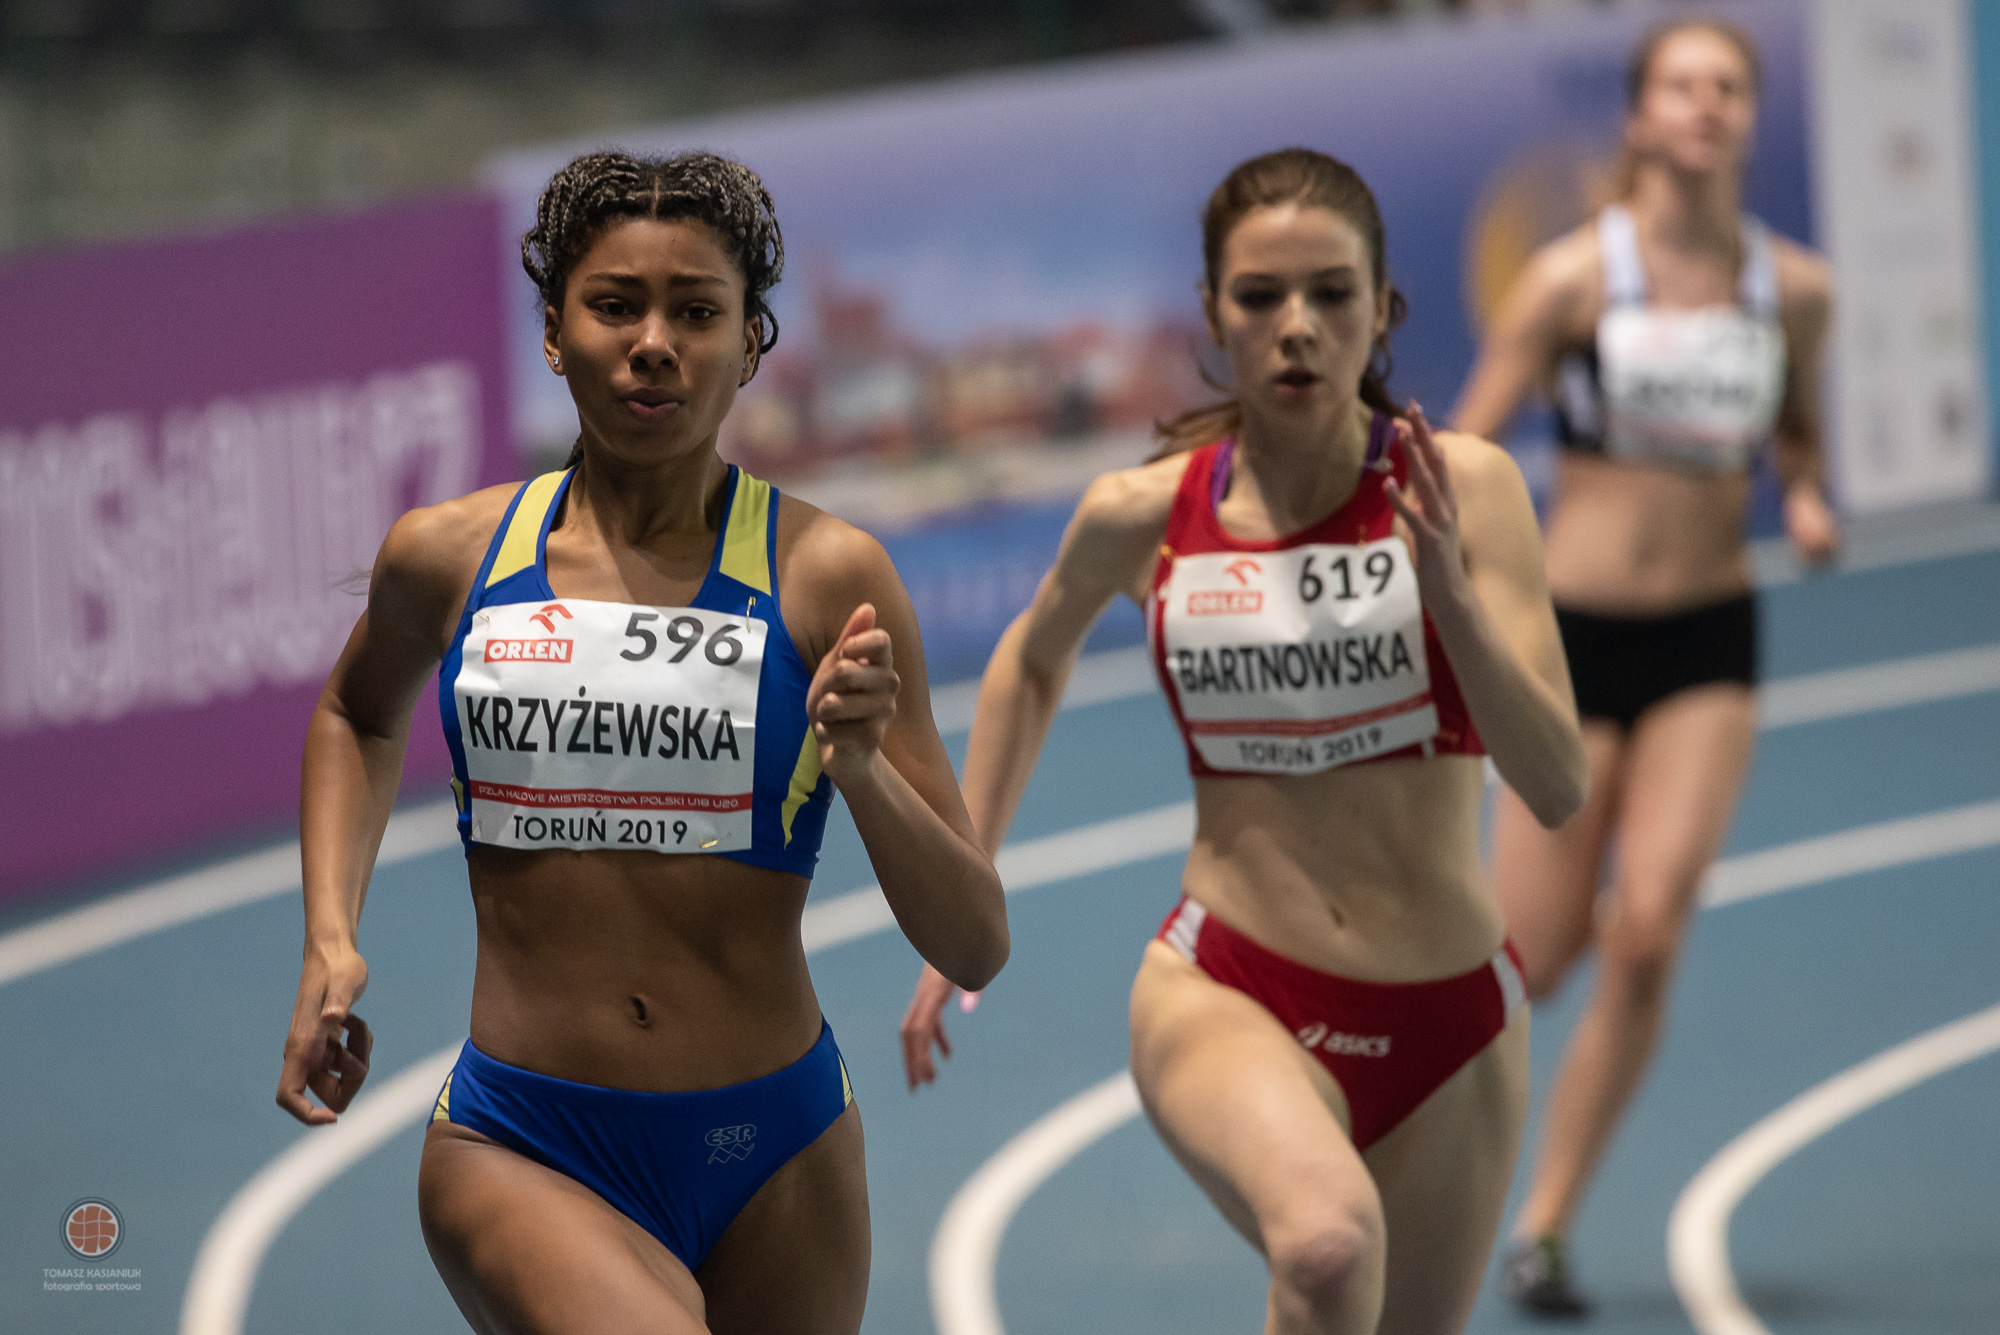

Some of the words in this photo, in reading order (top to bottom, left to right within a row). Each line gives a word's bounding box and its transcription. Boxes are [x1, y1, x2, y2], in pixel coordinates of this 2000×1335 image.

[1300, 551, 1394, 604] 619
[488, 641, 568, 661] ORLEN
[620, 612, 743, 667] 596
[1178, 631, 1413, 693] BARTNOWSKA
[465, 685, 740, 762] KRZYŻEWSKA
[478, 785, 505, 798] PZLA
[505, 789, 546, 803] HALOWE
[548, 793, 638, 805] MISTRZOSTWA
[640, 795, 685, 806] POLSKI
[712, 798, 739, 809] U20
[513, 810, 607, 842] TORUŃ
[617, 819, 688, 844] 2019
